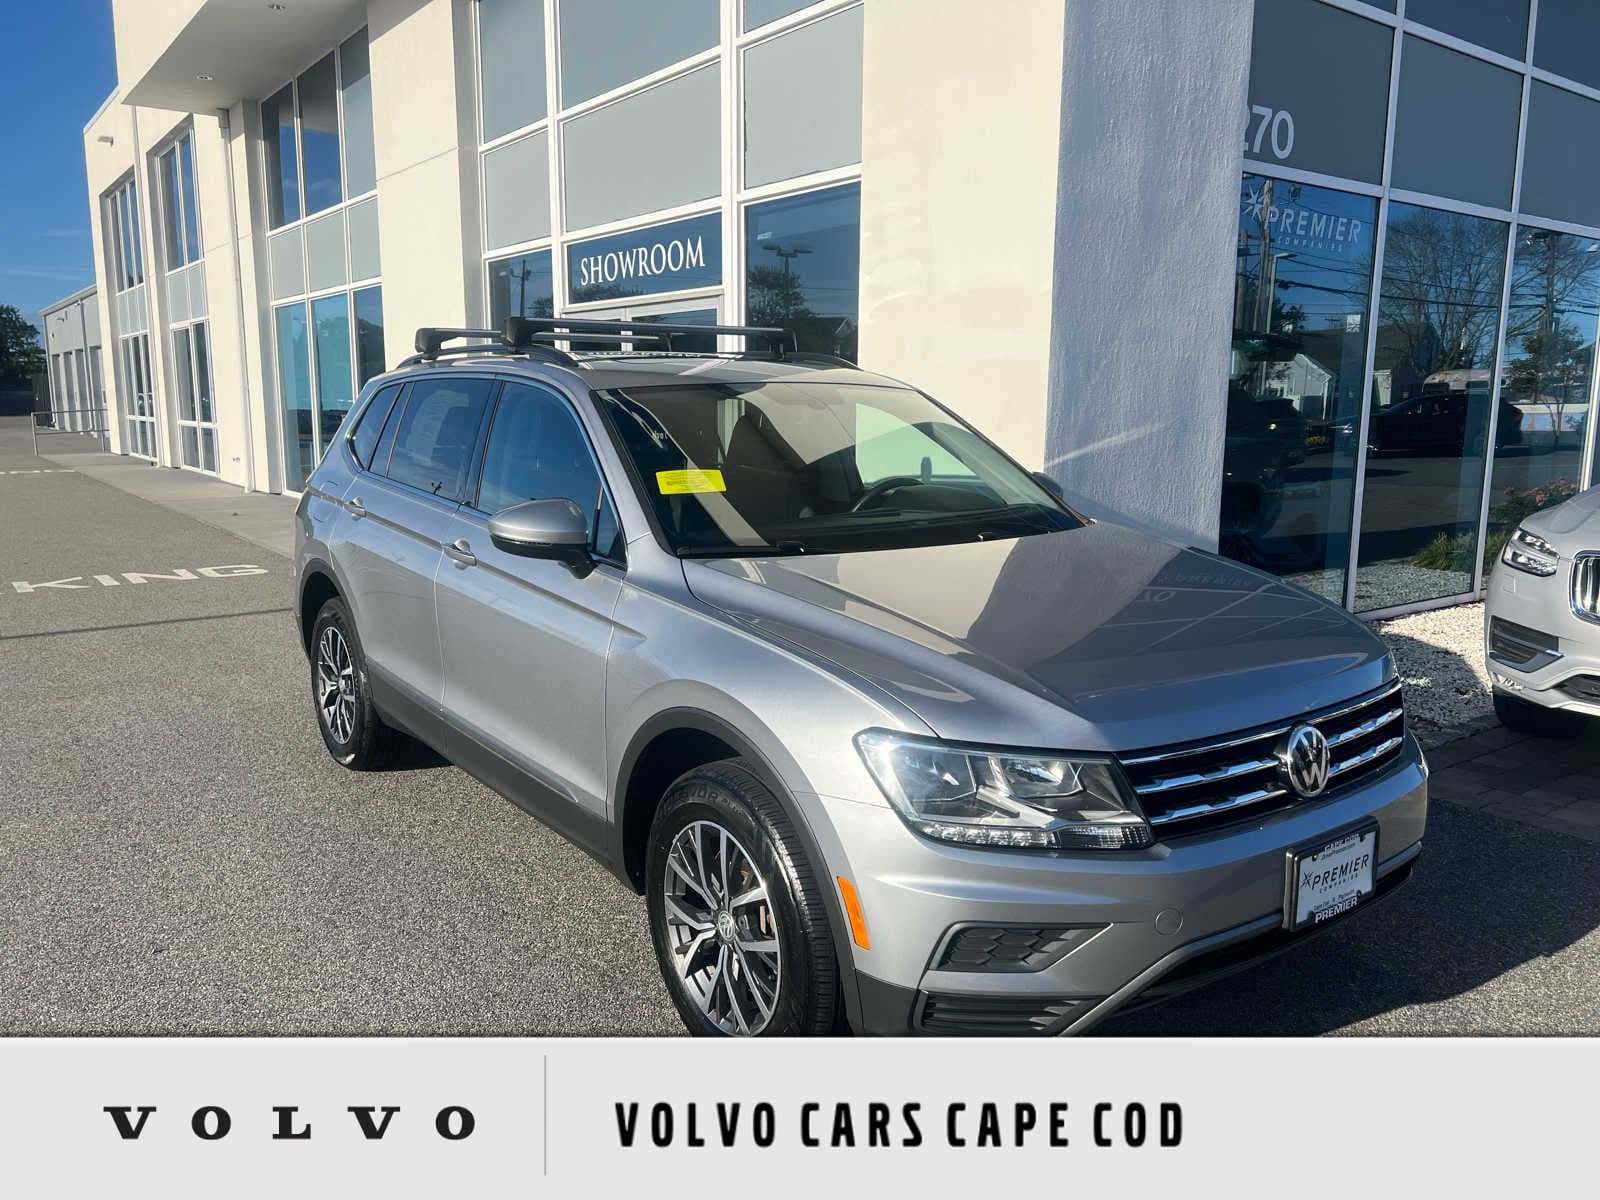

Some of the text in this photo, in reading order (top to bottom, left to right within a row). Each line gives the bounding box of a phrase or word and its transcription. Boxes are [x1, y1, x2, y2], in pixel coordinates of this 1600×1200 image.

[1263, 206, 1361, 244] PREMIER
[580, 235, 705, 286] SHOWROOM
[1311, 854, 1369, 891] PREMIER
[1314, 896, 1358, 924] PREMIER
